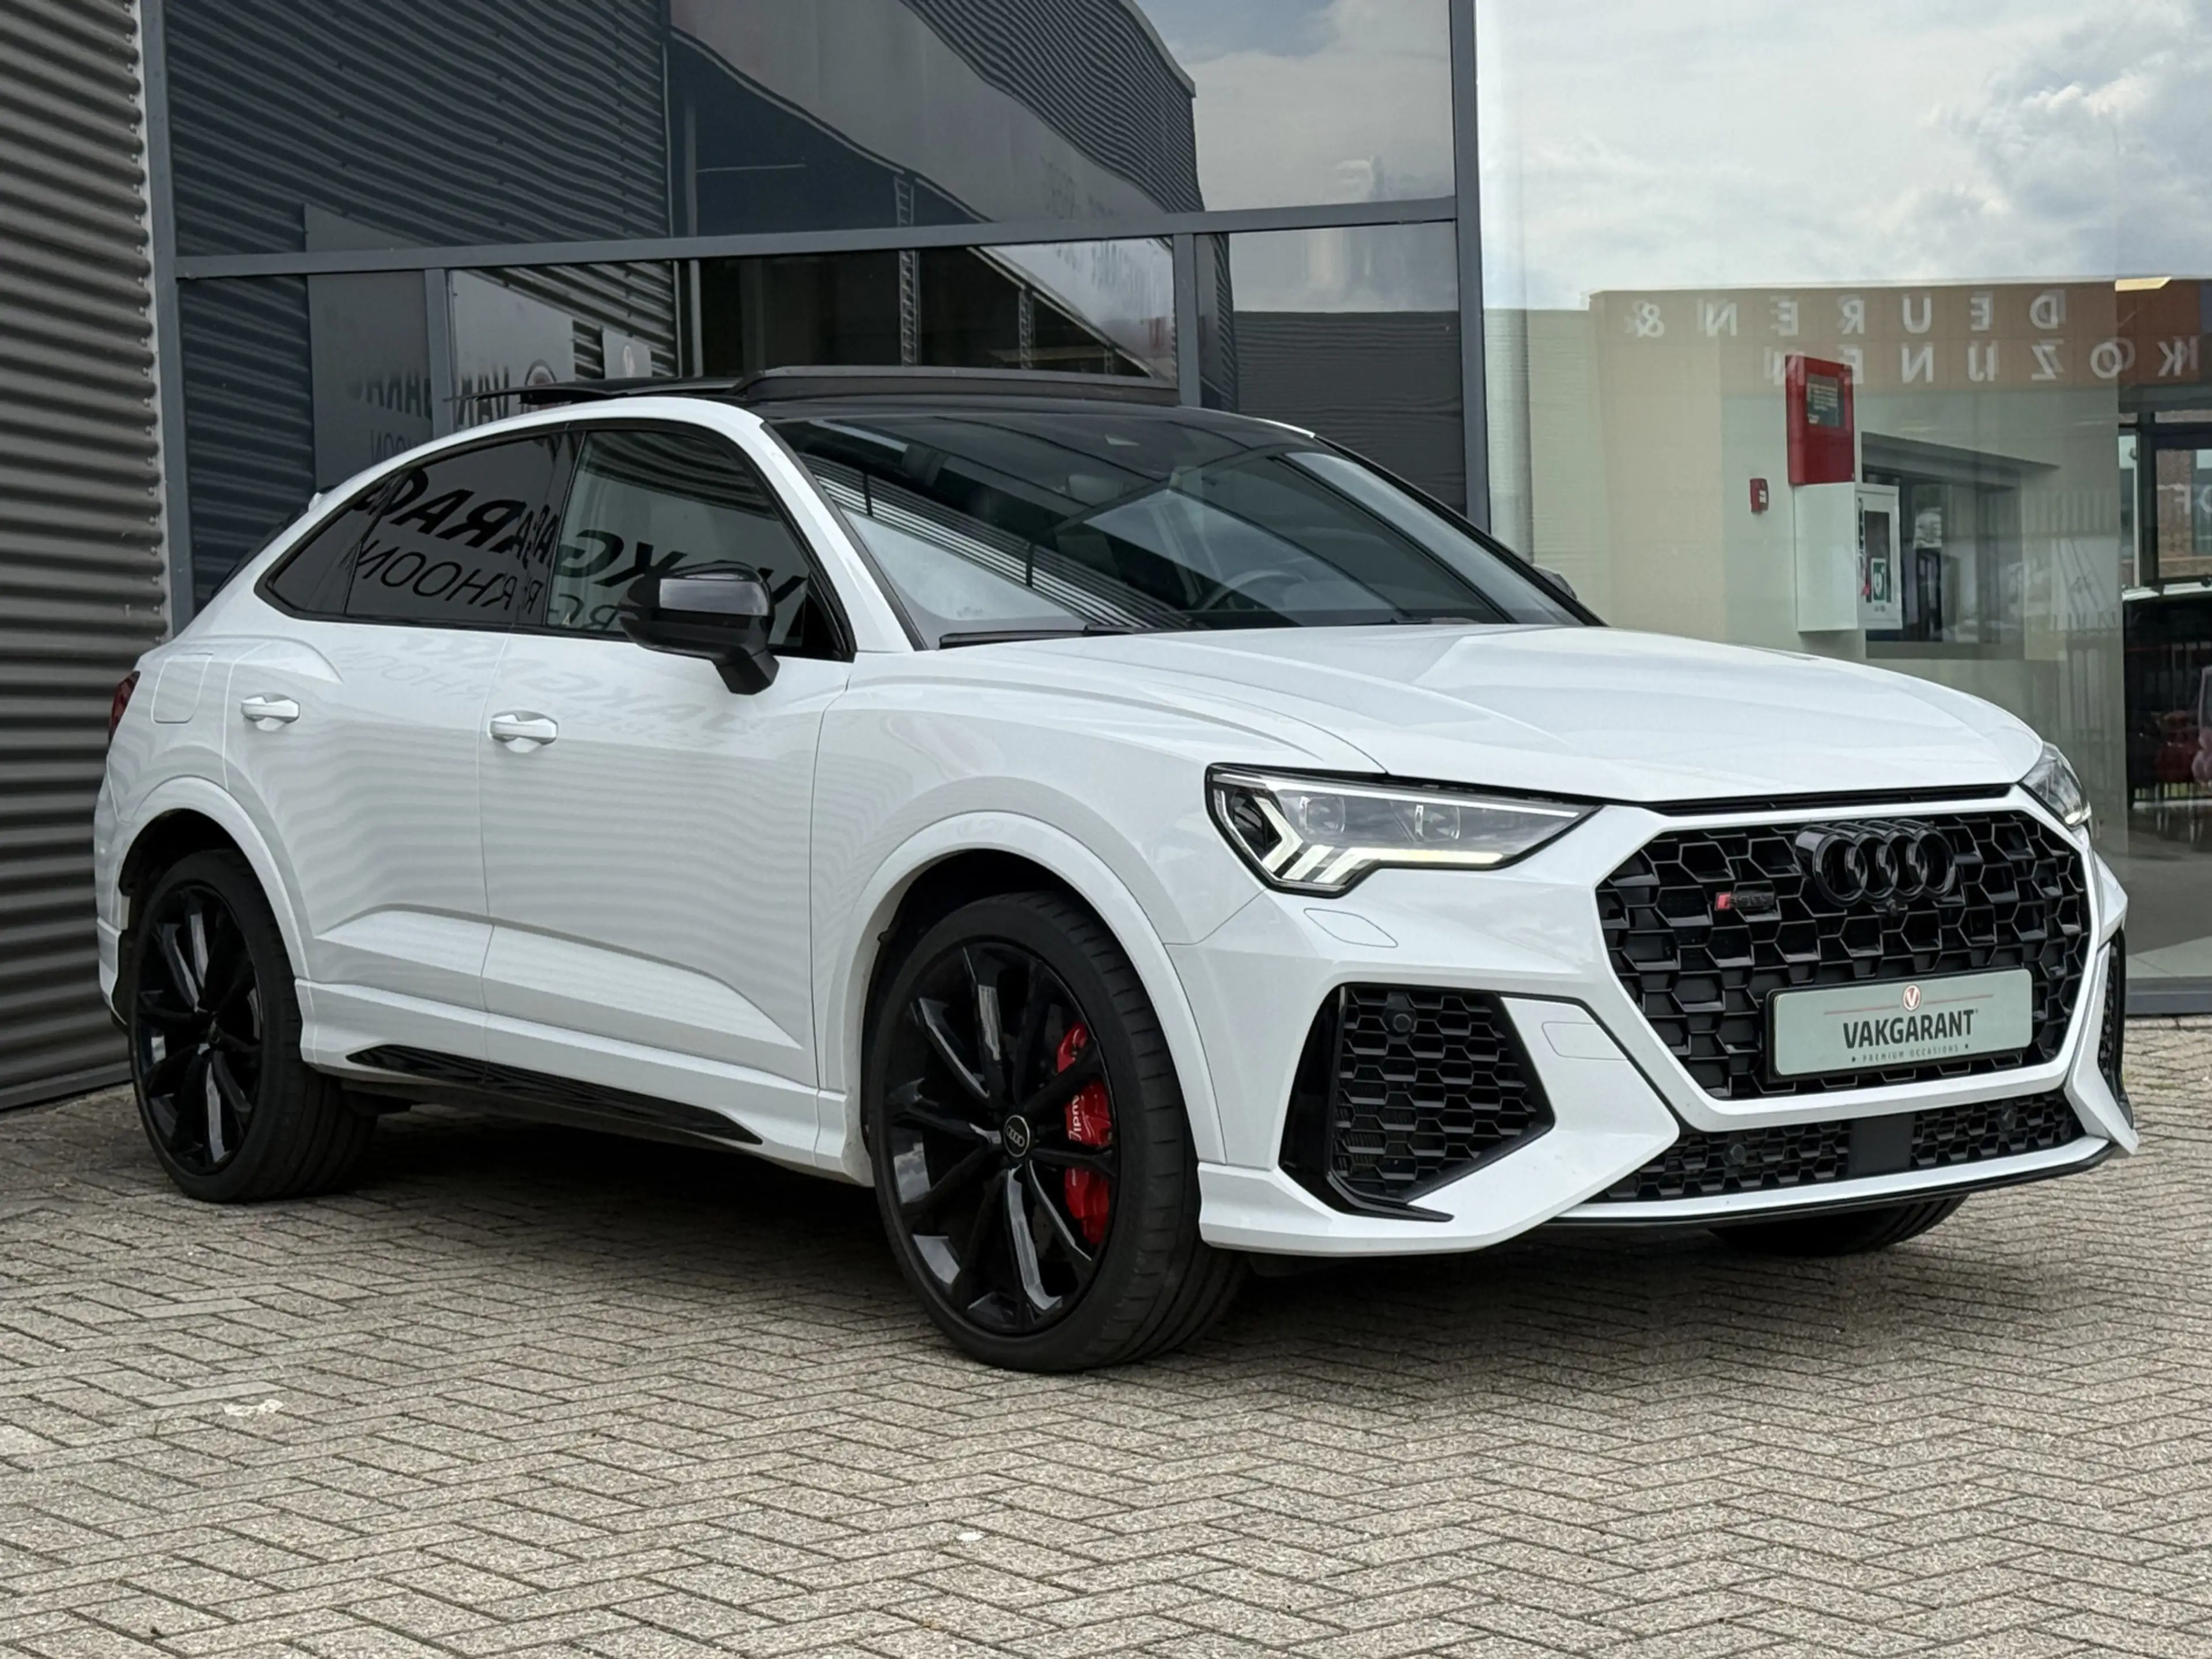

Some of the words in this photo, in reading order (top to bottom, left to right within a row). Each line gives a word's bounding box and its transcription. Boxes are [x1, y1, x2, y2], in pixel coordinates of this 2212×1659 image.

[1843, 1009, 1975, 1050] VAKGARANT
[1862, 1052, 1904, 1063] PREMIUM
[1909, 1044, 1959, 1058] OCCASIONS
